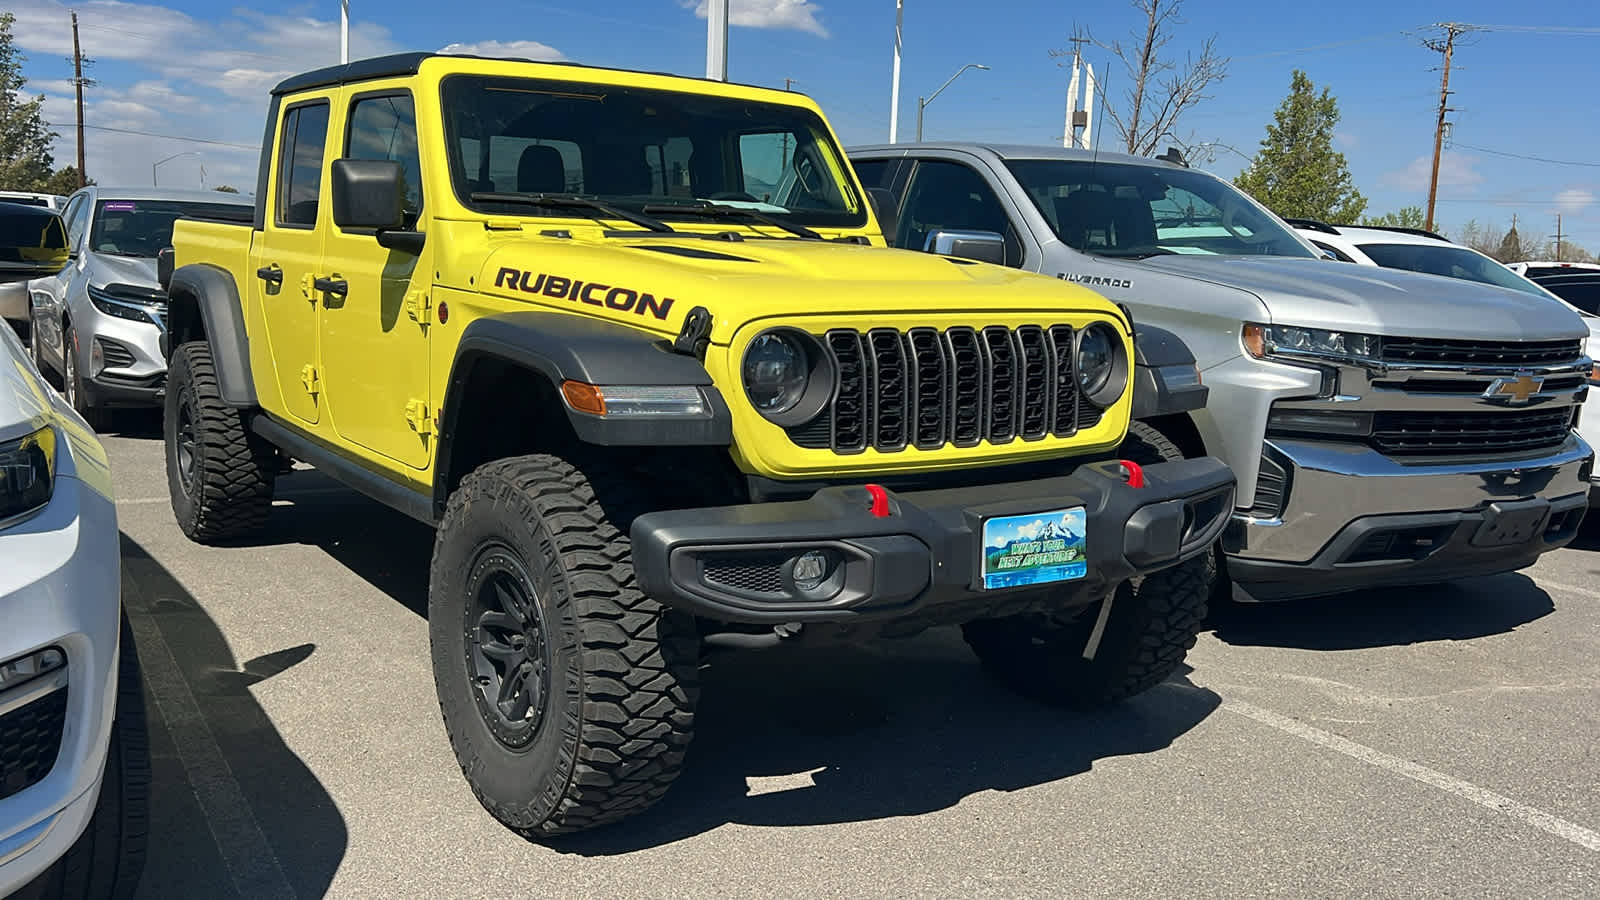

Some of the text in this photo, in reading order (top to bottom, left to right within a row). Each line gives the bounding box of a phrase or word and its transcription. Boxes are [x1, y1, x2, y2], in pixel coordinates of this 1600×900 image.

[1056, 272, 1134, 288] SILVERADO
[494, 267, 675, 321] RUBICON
[1042, 539, 1065, 552] YOUR
[998, 549, 1077, 569] NEXT ADVENTURE?
